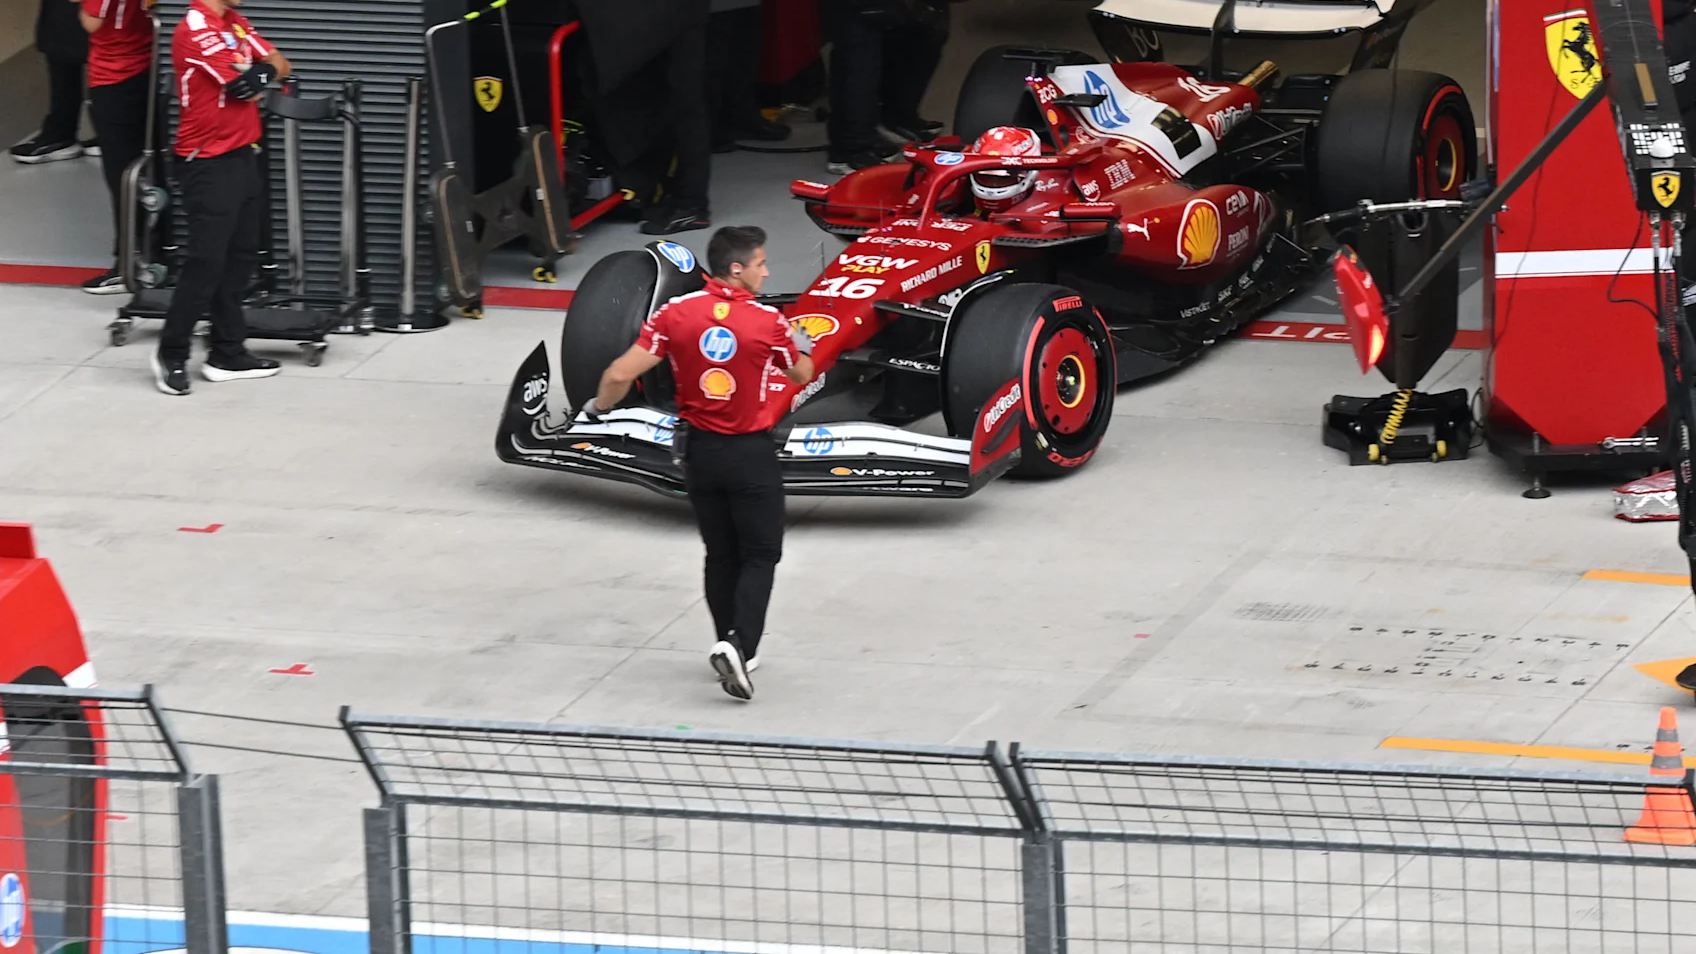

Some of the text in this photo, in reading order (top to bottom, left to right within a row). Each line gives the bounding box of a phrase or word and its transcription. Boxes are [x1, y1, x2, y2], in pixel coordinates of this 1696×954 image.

[1039, 84, 1057, 103] ZCG
[1083, 70, 1131, 129] hp
[1177, 77, 1231, 102] 16
[1001, 157, 1022, 165] DXC
[1104, 159, 1136, 190] IBM
[1081, 180, 1100, 196] aws
[870, 235, 952, 252] GENESYS
[656, 241, 695, 273] hp
[839, 254, 919, 269] VGW
[840, 265, 890, 274] PLAY
[901, 256, 963, 292] RICHARD MILLE
[809, 276, 885, 299] 16
[1052, 296, 1083, 312] PIRELLI
[699, 326, 738, 362] hp
[888, 358, 941, 371] ESPACIO
[524, 378, 548, 402] aws
[989, 383, 1021, 423] UniCredit
[804, 427, 834, 455] hp
[852, 467, 935, 477] V-Power
